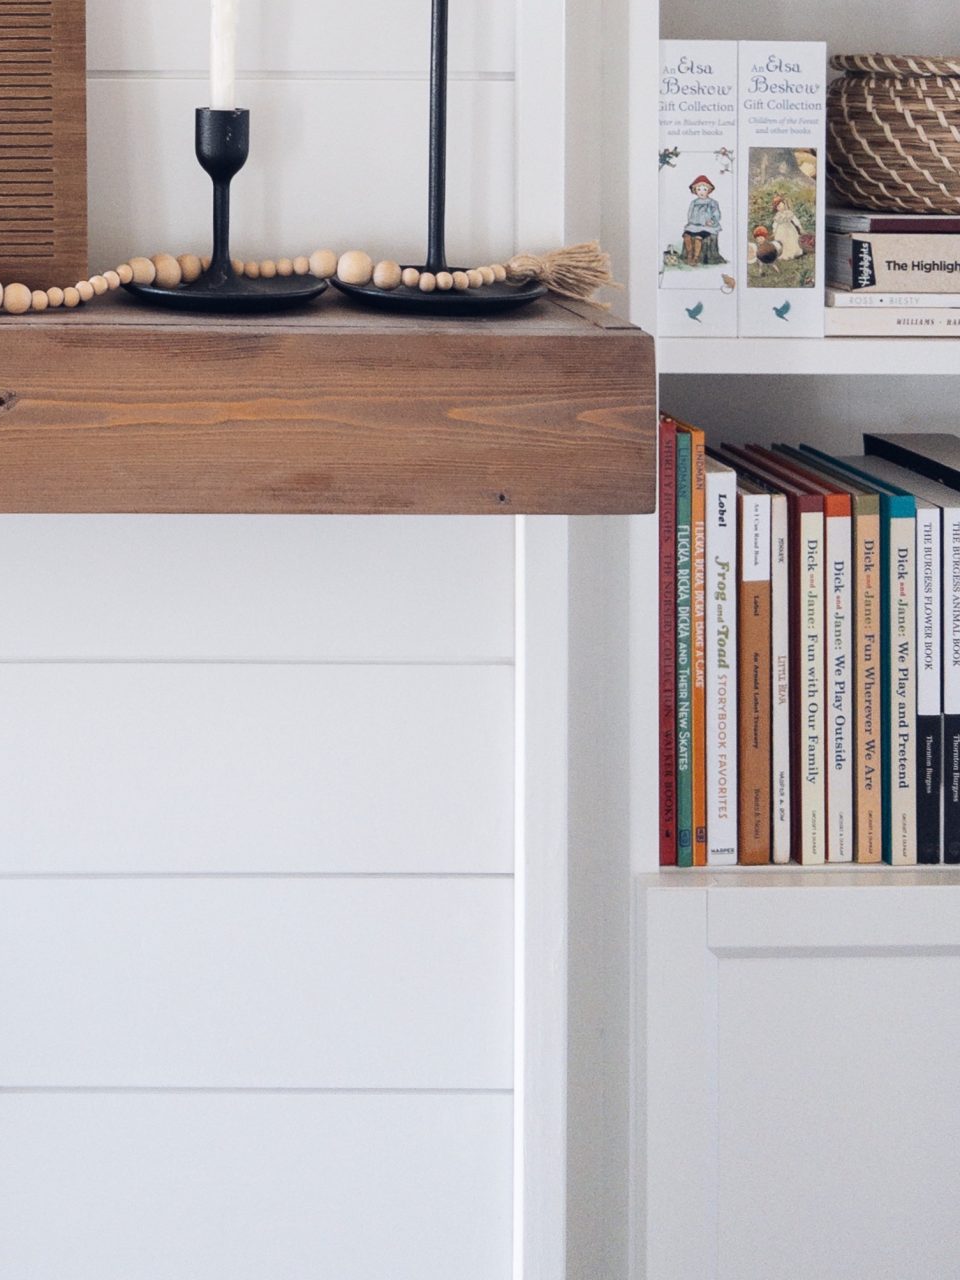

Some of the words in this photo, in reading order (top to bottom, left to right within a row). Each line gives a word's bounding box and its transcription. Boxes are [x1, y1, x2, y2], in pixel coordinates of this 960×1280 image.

[662, 66, 676, 75] An
[677, 55, 714, 75] Elsa
[751, 64, 765, 73] An
[766, 54, 801, 74] Elsa
[658, 76, 733, 96] Beskow
[747, 75, 820, 95] Beskow
[678, 100, 735, 112] Collection
[743, 99, 764, 111] Gift
[766, 98, 822, 111] Collection
[667, 128, 680, 136] and
[682, 128, 702, 136] other
[704, 128, 724, 136] books
[748, 117, 778, 125] Children
[755, 127, 769, 135] and
[770, 127, 790, 135] other
[791, 127, 811, 135] books
[858, 242, 872, 287] Highlights
[885, 261, 908, 271] The
[849, 297, 873, 305] ROSS
[889, 297, 920, 305] BIESTY
[665, 440, 673, 488] SHIRLEY
[679, 448, 688, 498] LINDMAN
[696, 444, 704, 490] LINDMAN
[664, 493, 672, 542] HUGHES
[718, 494, 727, 527] Lobel
[677, 525, 689, 566] FLICKA,
[694, 521, 704, 555] FLICKA,
[924, 522, 932, 544] THE
[664, 554, 672, 575] THE
[808, 540, 818, 571] Dick
[864, 540, 874, 572] Dick
[898, 548, 908, 580] Dick
[924, 547, 932, 593] BURGESS
[952, 546, 960, 592] BURGESS
[678, 569, 689, 603] RICKA,
[695, 560, 704, 588] RICKA,
[715, 556, 730, 601] Frog
[834, 561, 845, 593] Dick
[695, 591, 704, 616] DICKA
[808, 591, 817, 628] Jane:
[864, 591, 874, 628] Jane:
[898, 599, 908, 636] Jane:
[924, 596, 932, 638] FLOWER
[952, 594, 960, 636] ANIMAL
[678, 606, 689, 637] DICKA
[696, 622, 704, 646] BAKE
[834, 612, 844, 650] Jane:
[679, 642, 688, 664] AND
[717, 625, 729, 669] Toad
[808, 634, 818, 662] Fun
[864, 634, 874, 662] Fun
[898, 642, 909, 662] We
[924, 642, 932, 670] BOOK
[952, 639, 960, 666] BOOK
[696, 660, 704, 688] CAKE
[778, 656, 787, 682] LITTLE
[835, 654, 845, 676] We
[680, 668, 690, 698] THEIR
[778, 684, 787, 704] BEAR
[808, 667, 818, 698] with
[833, 680, 845, 710] Play
[896, 668, 908, 698] Play
[680, 702, 690, 728] NEW
[718, 674, 727, 749] STORYBOOK
[864, 666, 875, 735] Wherever
[899, 702, 909, 728] and
[808, 702, 818, 730] Our
[679, 731, 690, 770] SKATES
[835, 715, 846, 770] Outside
[865, 739, 875, 760] We
[806, 735, 818, 784] Family
[899, 733, 909, 788] Pretend
[718, 754, 728, 819] FAVORITES
[865, 765, 875, 790] Are
[924, 768, 932, 793] Burgess
[952, 773, 960, 802] Burgess
[665, 781, 673, 822] BOOKS
